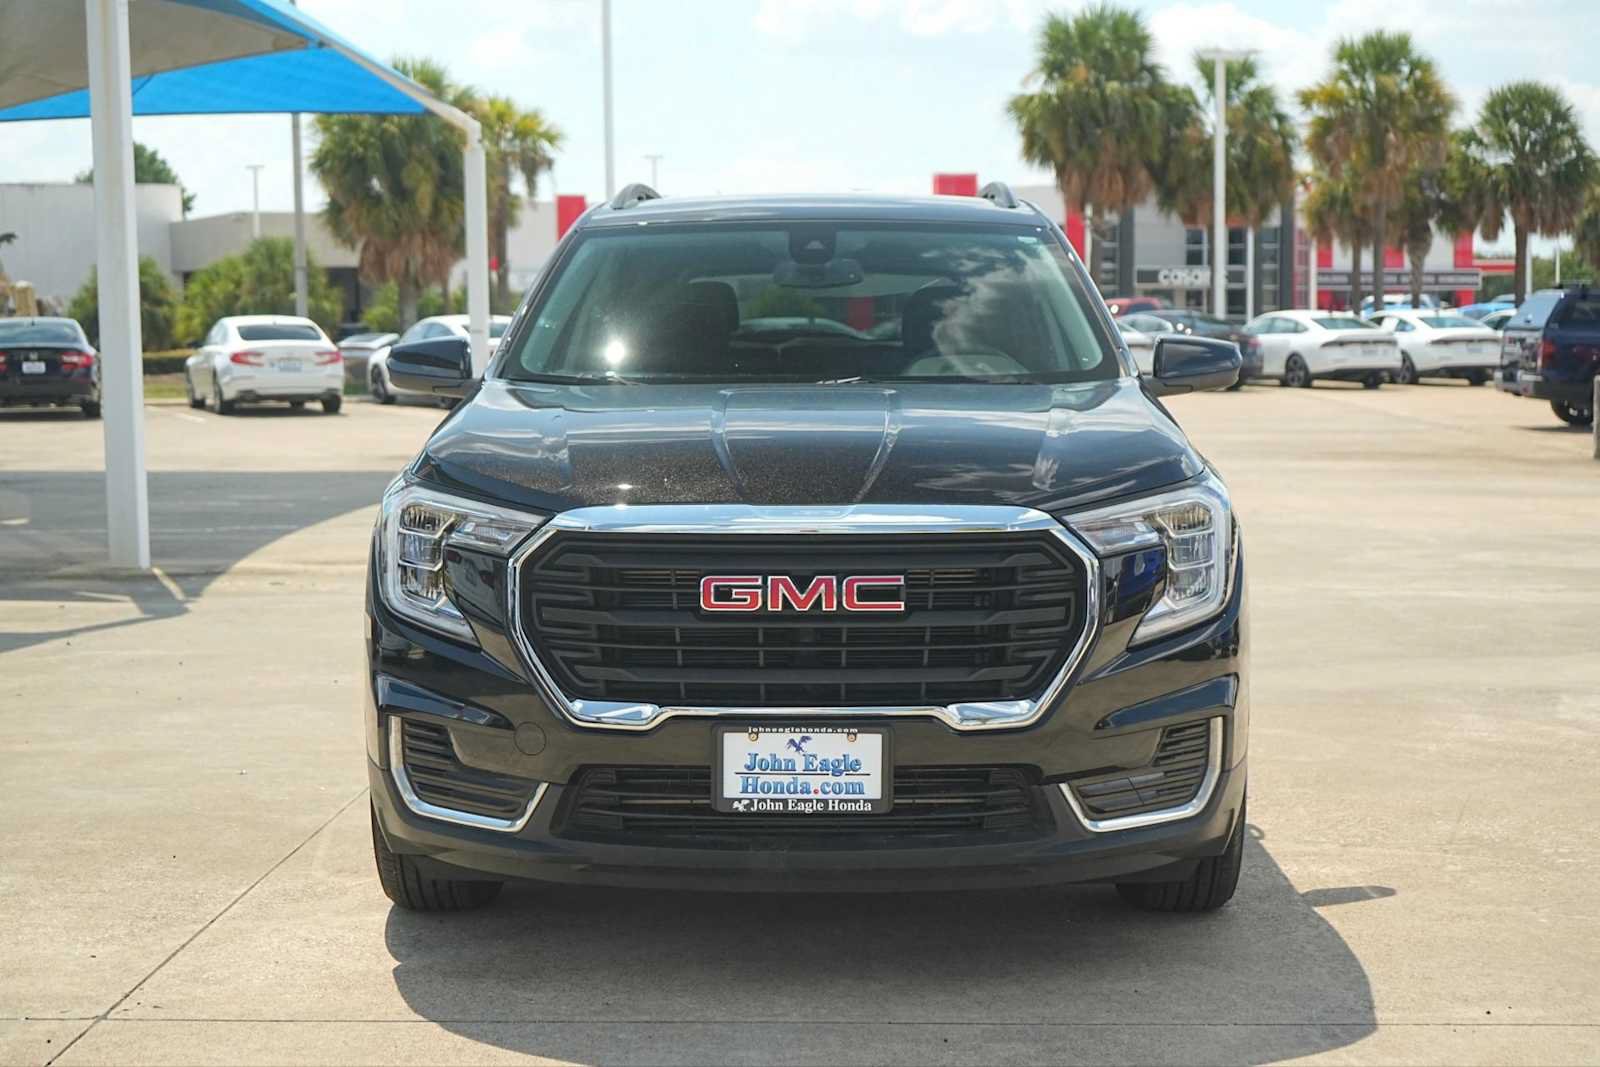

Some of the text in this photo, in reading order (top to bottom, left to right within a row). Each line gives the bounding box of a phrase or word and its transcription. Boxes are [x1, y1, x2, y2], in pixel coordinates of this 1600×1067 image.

[700, 575, 905, 612] GMC
[748, 726, 859, 734] johneaglehonda.com
[744, 752, 862, 777] John Eagle
[739, 776, 865, 795] Honda.com
[750, 799, 872, 814] John Eagle Honda
